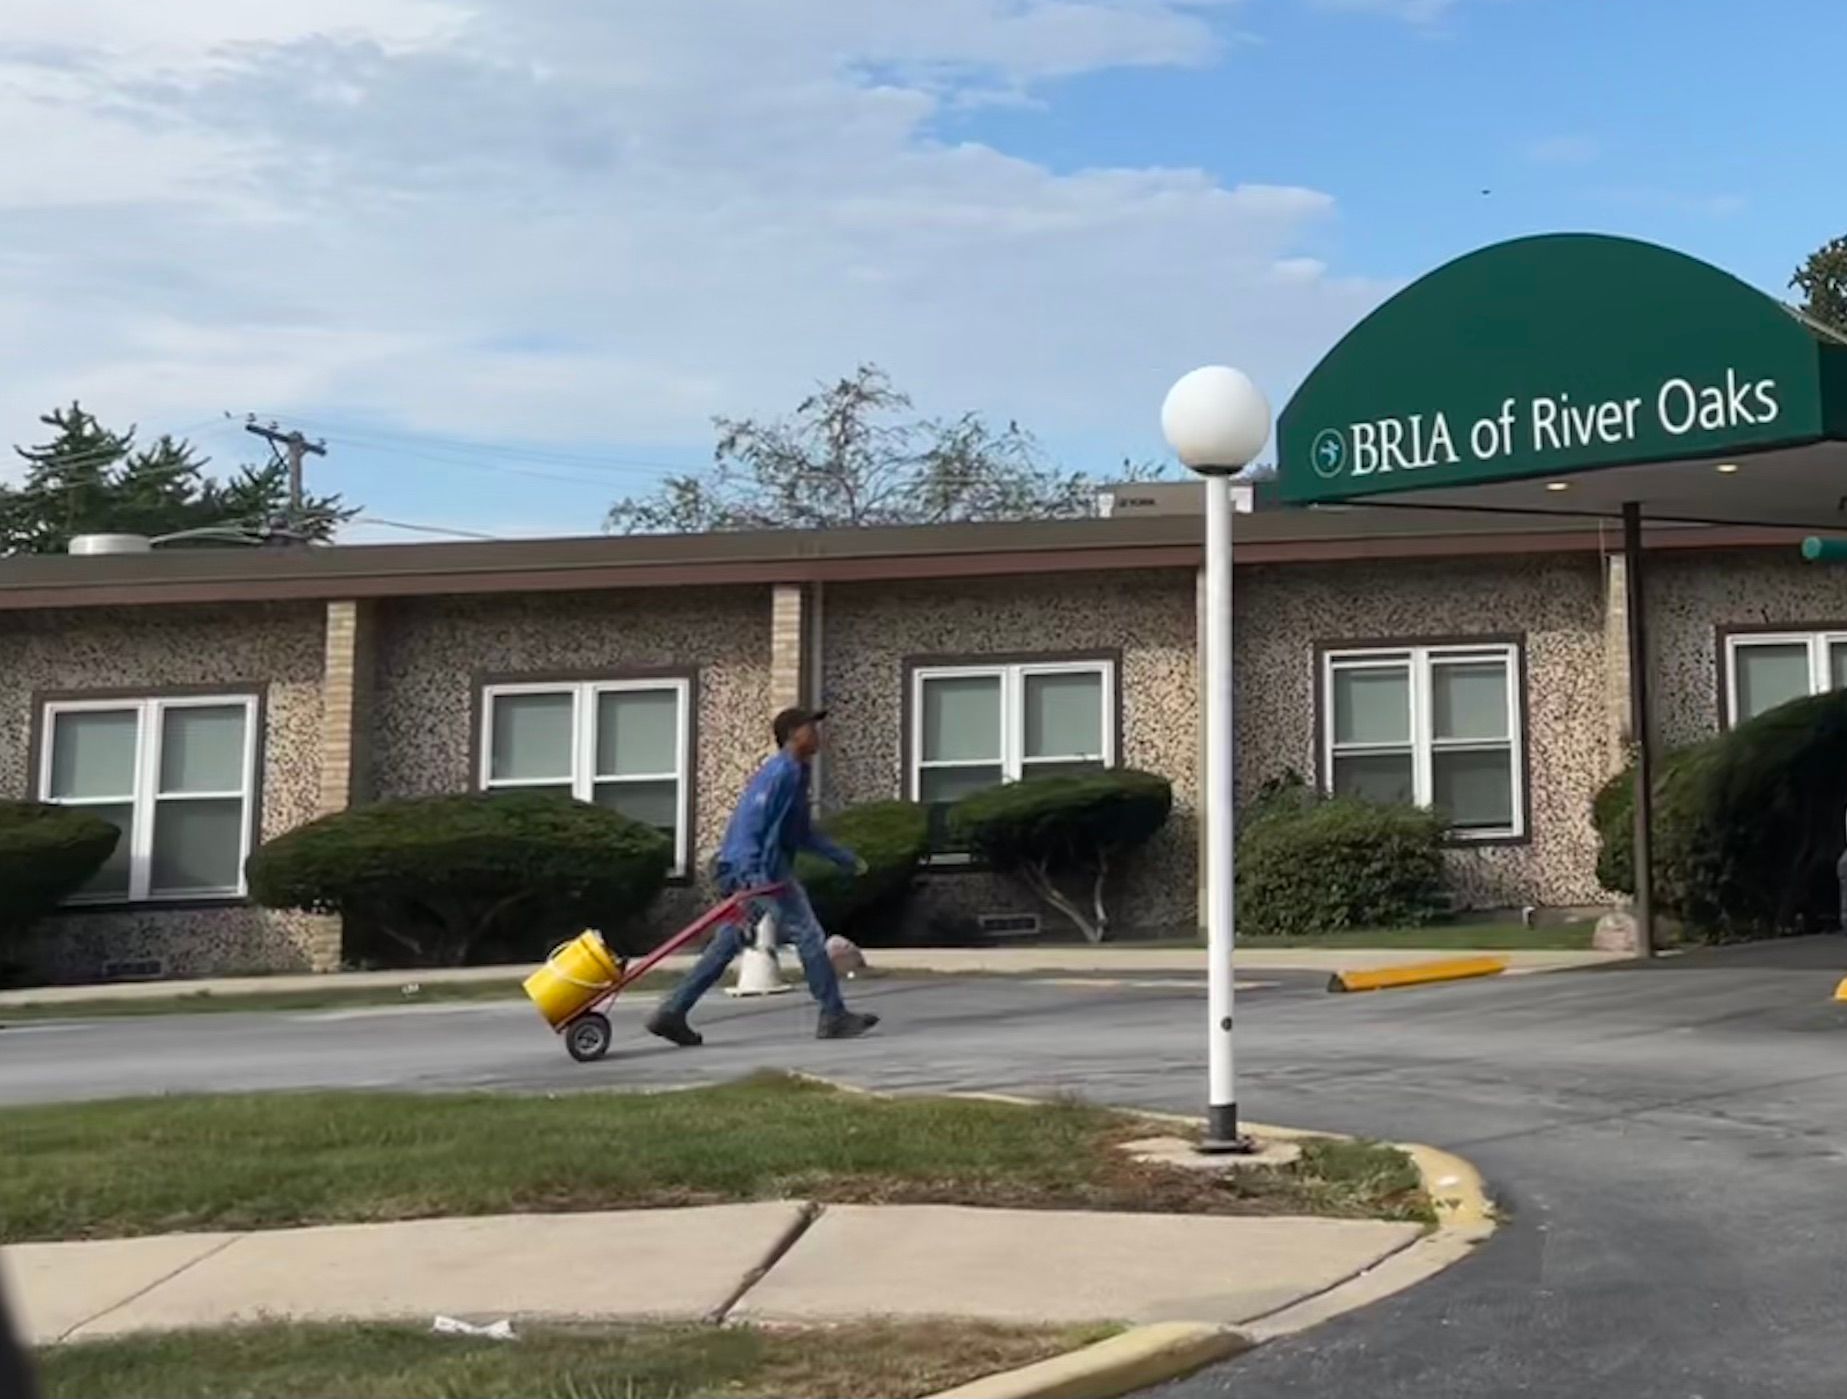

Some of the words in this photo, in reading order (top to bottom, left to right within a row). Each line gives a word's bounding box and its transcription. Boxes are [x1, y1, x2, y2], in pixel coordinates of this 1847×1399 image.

[1350, 411, 1460, 477] BRIA
[1470, 397, 1516, 460] of
[1531, 393, 1642, 451] River
[1657, 367, 1779, 435] Oaks
